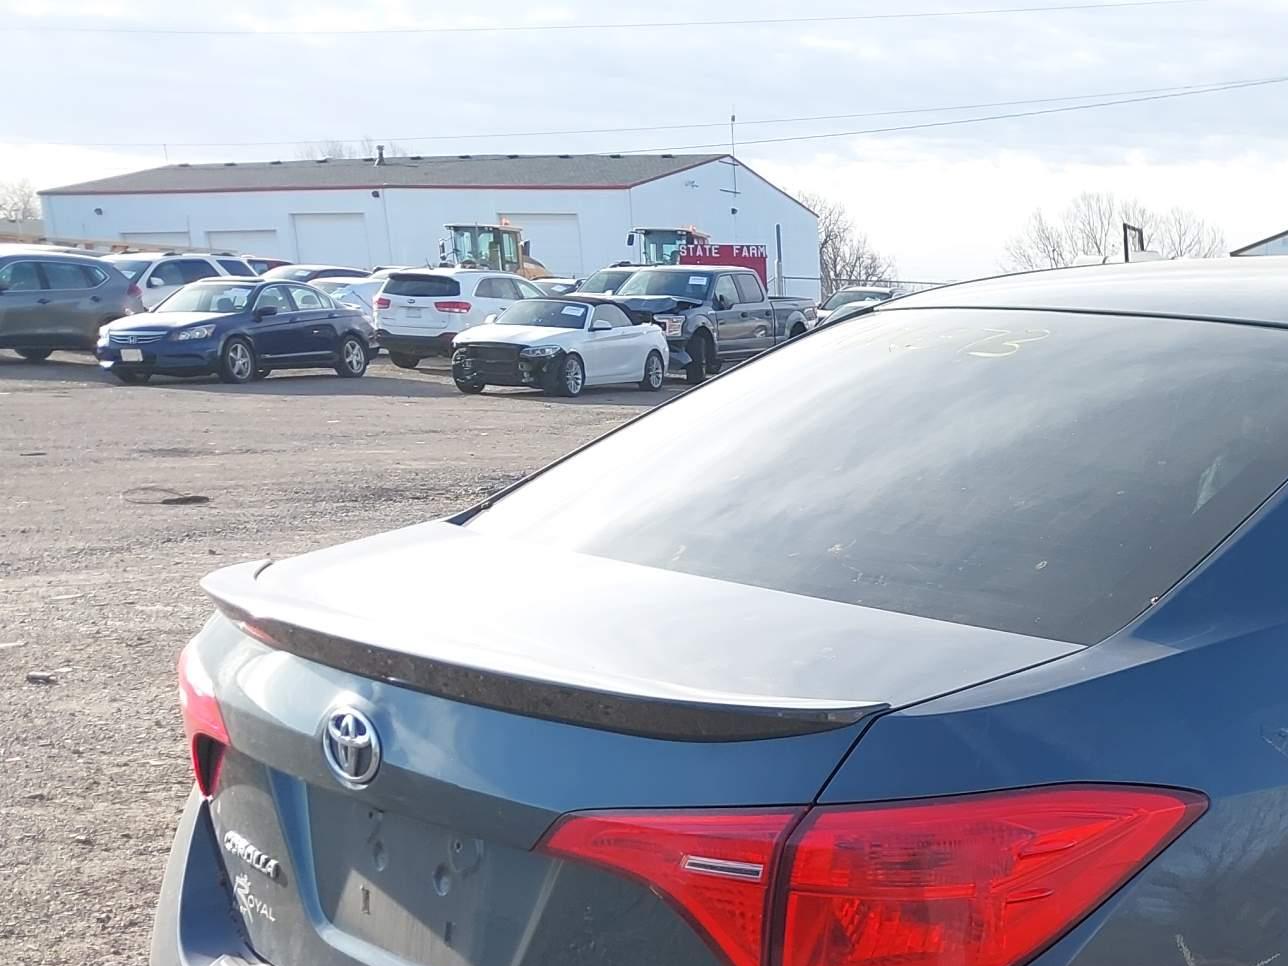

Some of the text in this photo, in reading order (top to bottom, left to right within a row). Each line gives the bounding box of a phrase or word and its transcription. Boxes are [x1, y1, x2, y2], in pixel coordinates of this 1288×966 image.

[680, 244, 766, 258] STATE FARM
[224, 830, 279, 878] COROLLA
